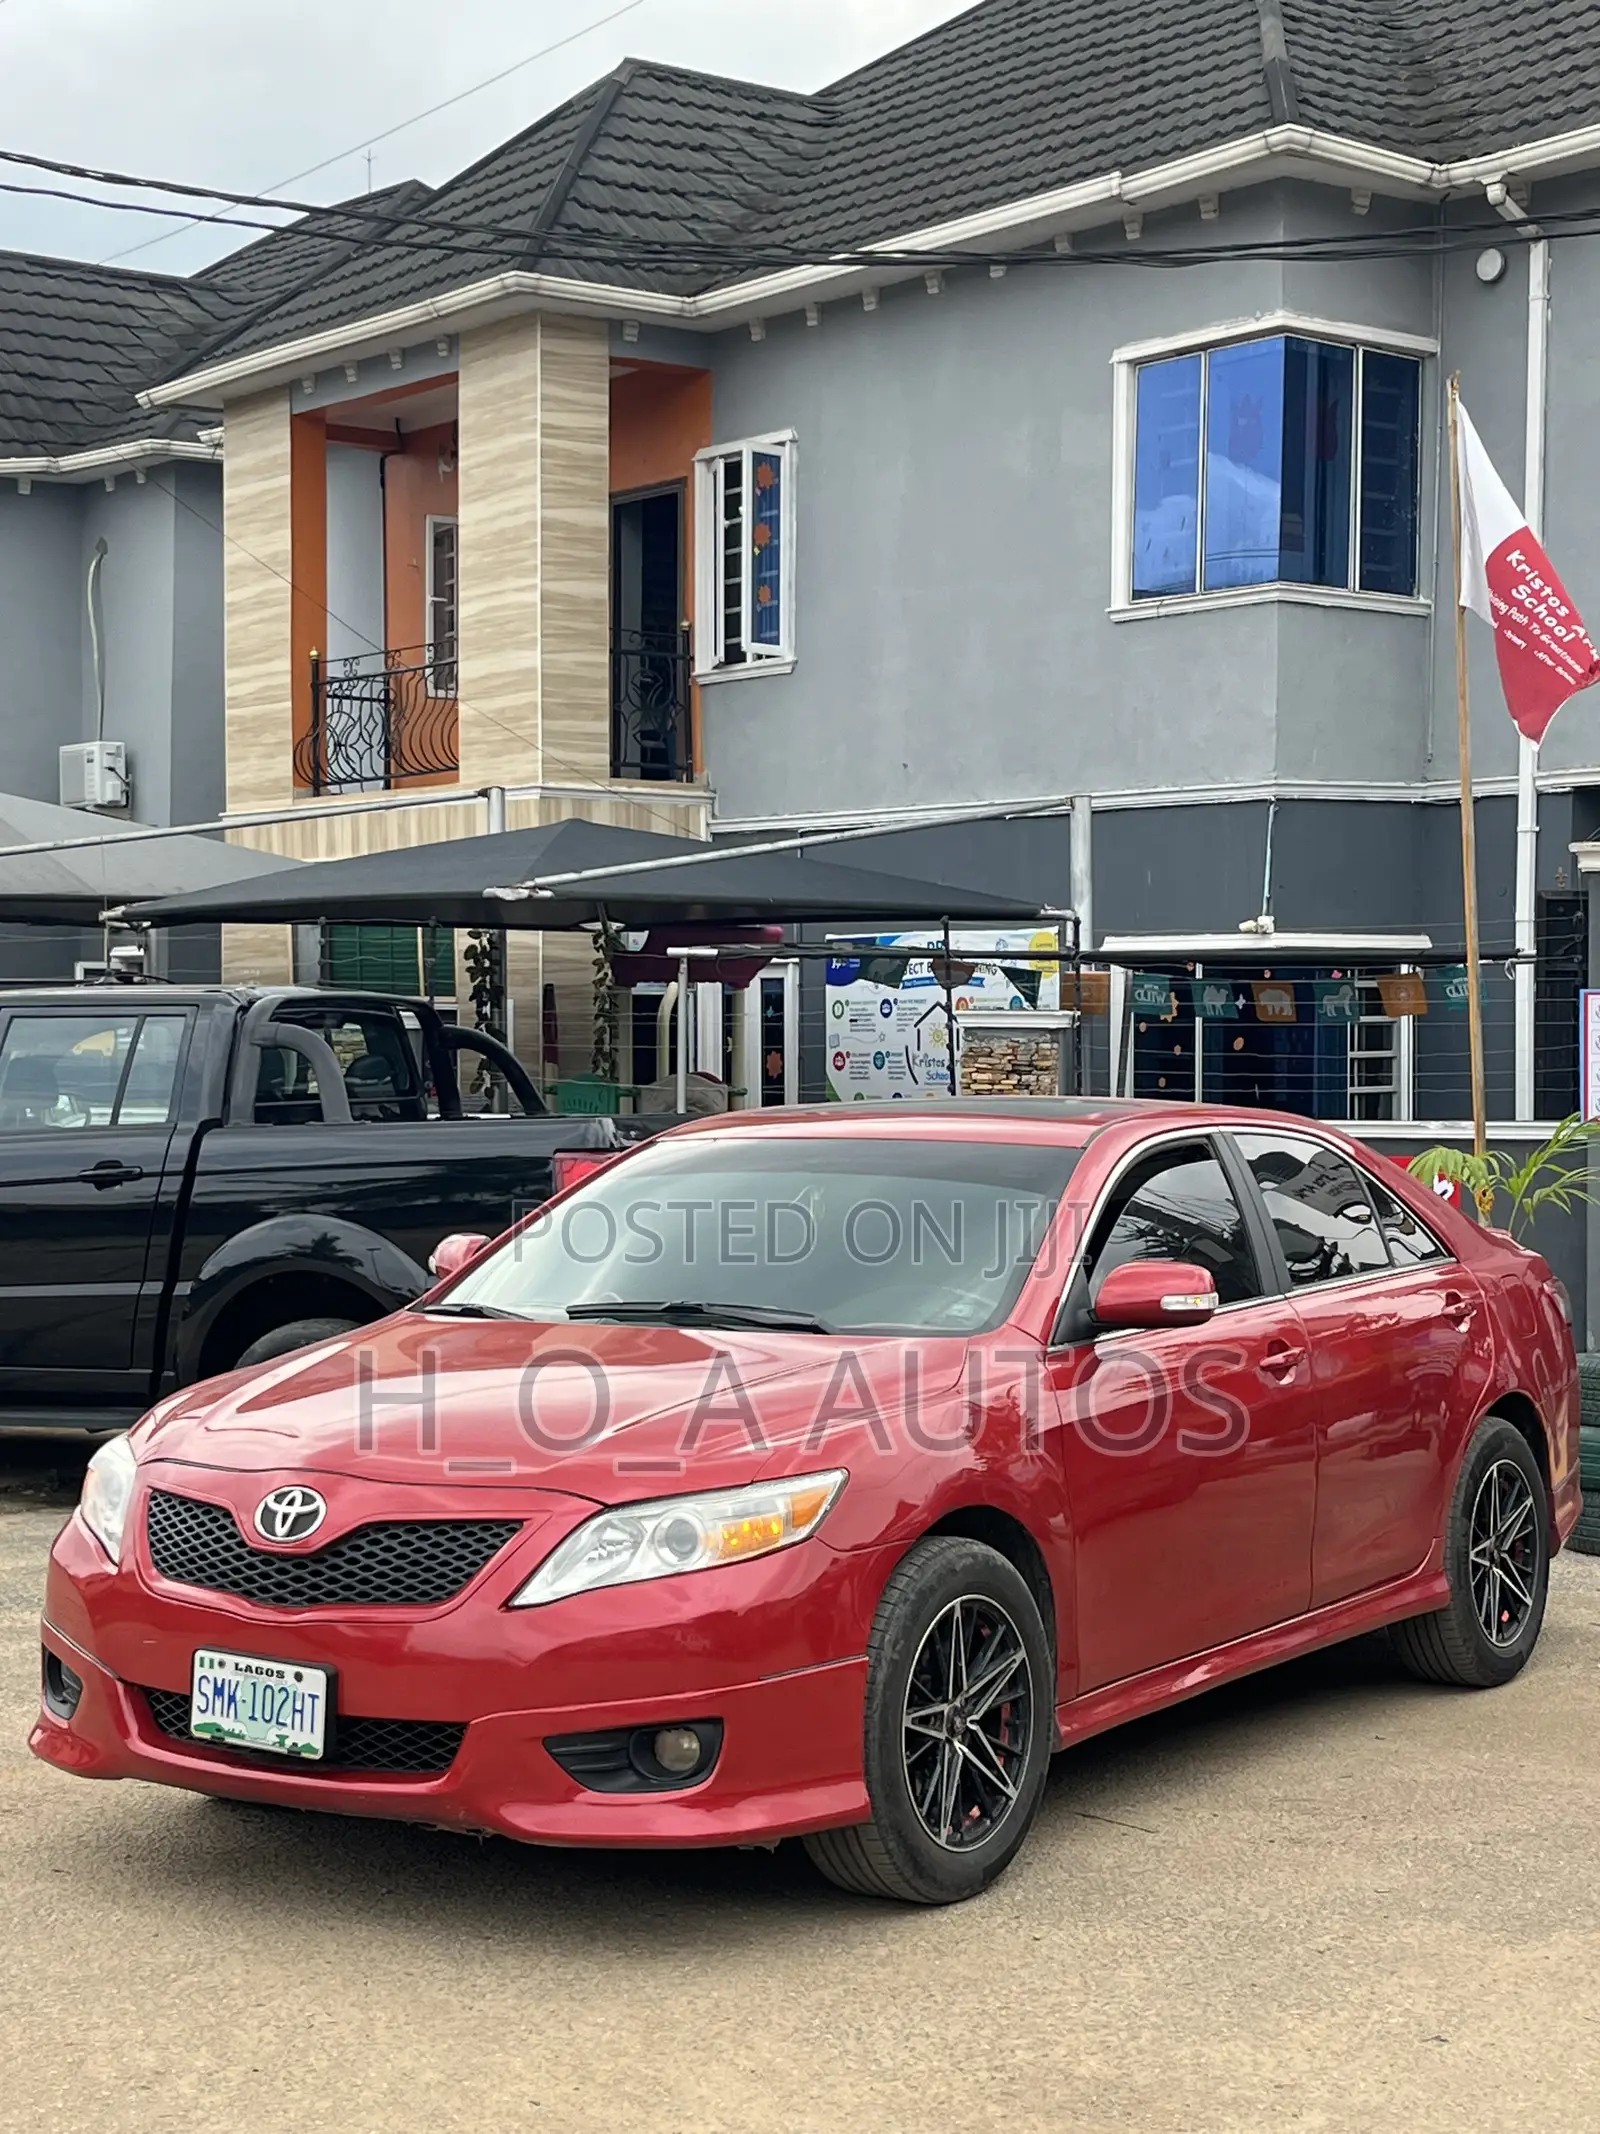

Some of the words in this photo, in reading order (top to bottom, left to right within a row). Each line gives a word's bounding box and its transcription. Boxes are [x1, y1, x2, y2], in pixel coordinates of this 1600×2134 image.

[1506, 549, 1570, 617] Kristos
[1508, 606, 1529, 626] Path
[1528, 622, 1542, 635] To
[1511, 584, 1577, 643] School
[912, 1052, 946, 1069] Kristos
[925, 1070, 950, 1081] Schoo
[233, 1661, 286, 1680] LAGOS
[197, 1674, 320, 1735] SMK-102HT
